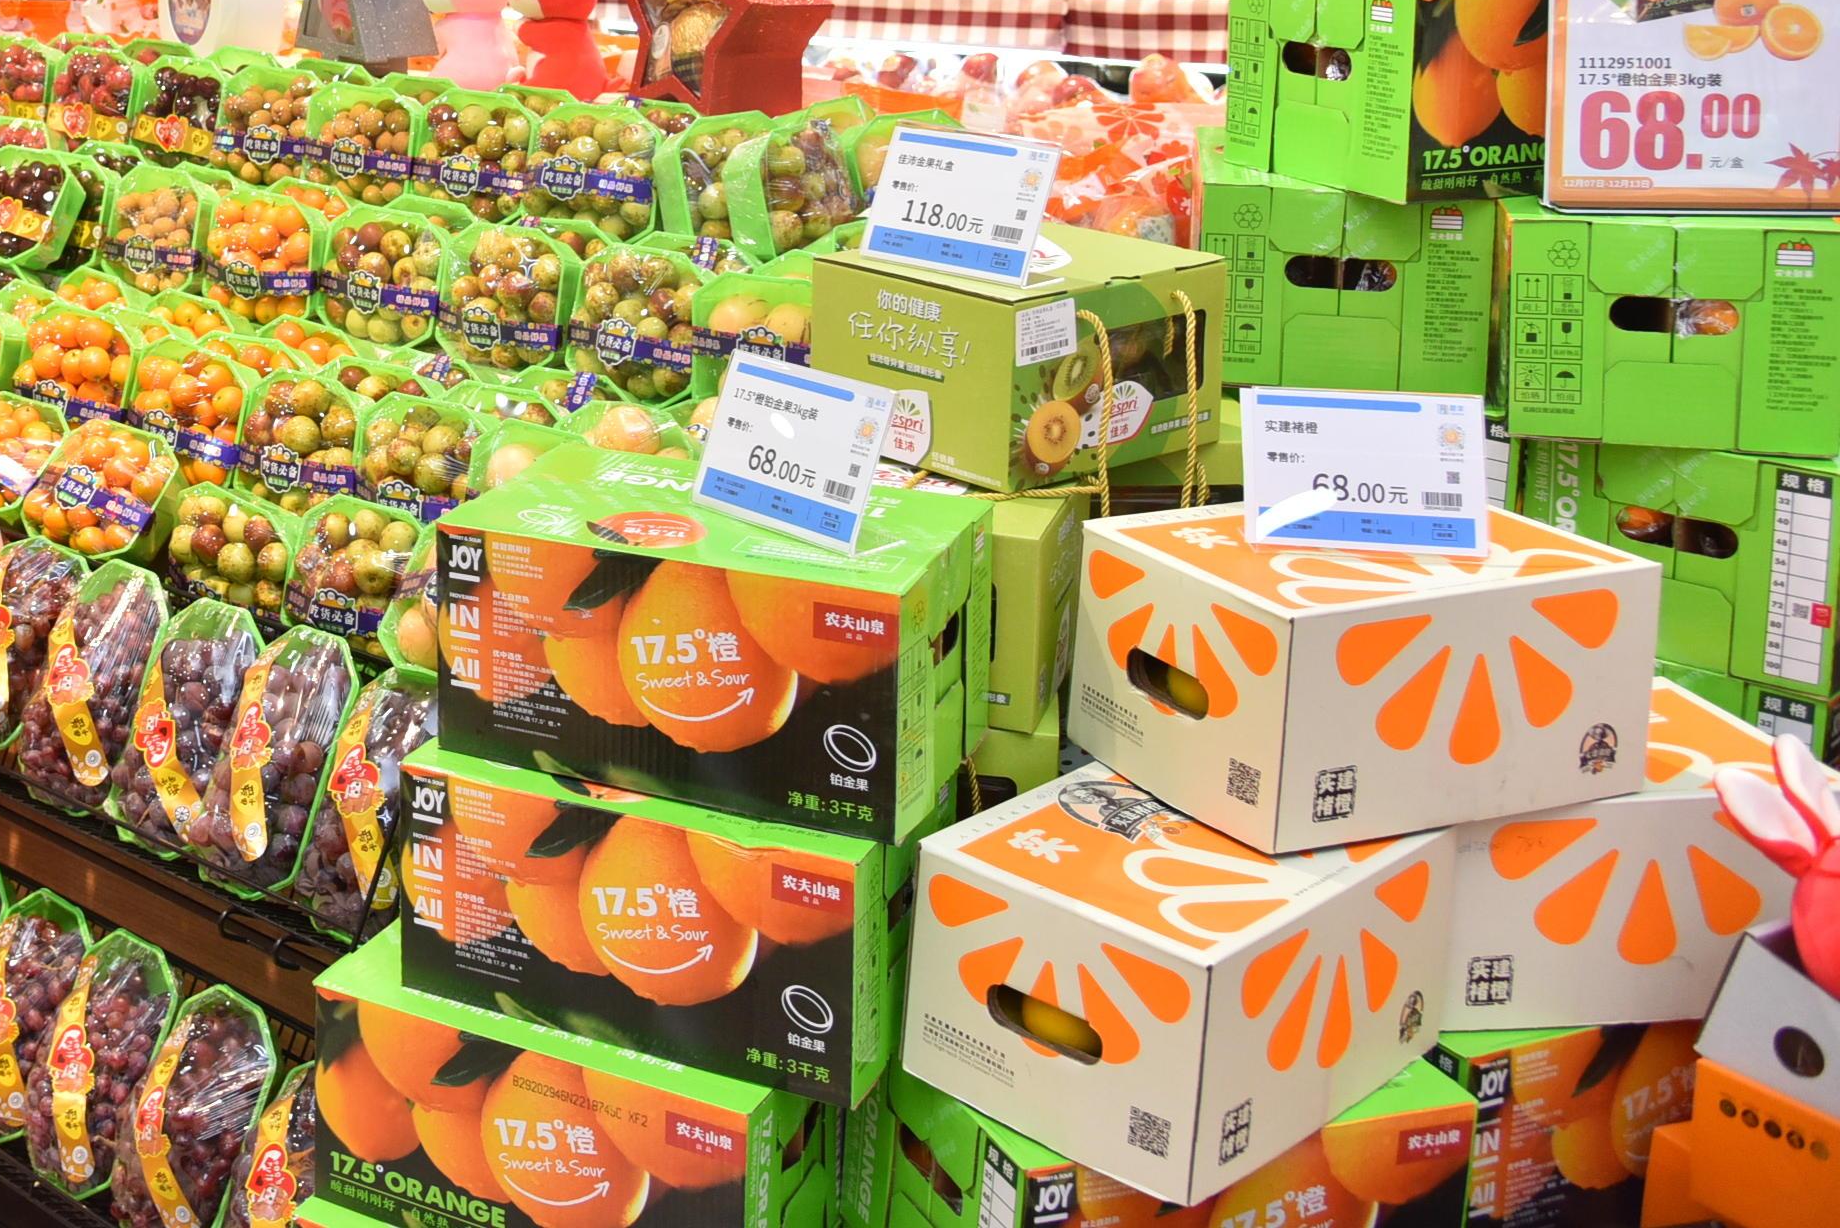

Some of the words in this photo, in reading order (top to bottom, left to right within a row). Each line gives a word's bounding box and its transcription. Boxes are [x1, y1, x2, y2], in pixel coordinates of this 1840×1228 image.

[1578, 57, 1672, 70] 1112951001
[1578, 73, 1723, 89] 17.5°橙铂金果3kg装
[1579, 90, 1761, 171] 68.00
[898, 153, 955, 172] 佳沛金果礼盒
[1709, 156, 1745, 170] 元/盒
[544, 171, 584, 188] 吃货必备
[901, 199, 984, 234] 118.00元
[877, 288, 942, 322] 你的健康
[598, 334, 634, 353] 吃货必备
[848, 311, 971, 368] 任你纵享!
[1110, 423, 1129, 438] 佳沛
[1264, 420, 1319, 435] 实建褚橙
[894, 437, 915, 452] 佳沛
[262, 461, 298, 480] 吃货必备
[748, 444, 817, 488] 68.00元
[1781, 472, 1826, 494] 规格
[448, 544, 483, 571] JOY
[310, 604, 355, 625] 吃货必备
[449, 602, 480, 629] IN
[824, 612, 886, 636] 农夫山泉
[631, 628, 742, 665] 17.5°橙
[636, 671, 692, 691] Sweet
[697, 671, 711, 686] &
[711, 669, 750, 688] Sour
[1763, 695, 1807, 719] 规格
[829, 773, 869, 791] 铂金果
[1319, 771, 1354, 793] 实建
[412, 786, 446, 814] JOY
[1316, 793, 1353, 817] 褚橙
[413, 843, 443, 870] IN
[782, 874, 841, 901] 农夫山泉
[592, 884, 701, 918] 17.5°橙
[596, 923, 653, 942] Sweet
[657, 923, 671, 939] &
[671, 923, 709, 942] Sour
[1470, 956, 1512, 979] 实建
[1468, 979, 1510, 1002] 褚橙
[787, 1032, 826, 1054] 铂金果
[1477, 1067, 1509, 1099] JOY
[493, 1117, 599, 1157] 17.5°橙
[675, 1121, 734, 1152] 农夫山泉
[1407, 1128, 1460, 1151] 农夫山泉
[1474, 1128, 1501, 1154] IN
[498, 1152, 555, 1174] Sweet
[555, 1158, 569, 1173] &
[568, 1160, 606, 1178] Sour
[1035, 1182, 1074, 1213] JOY
